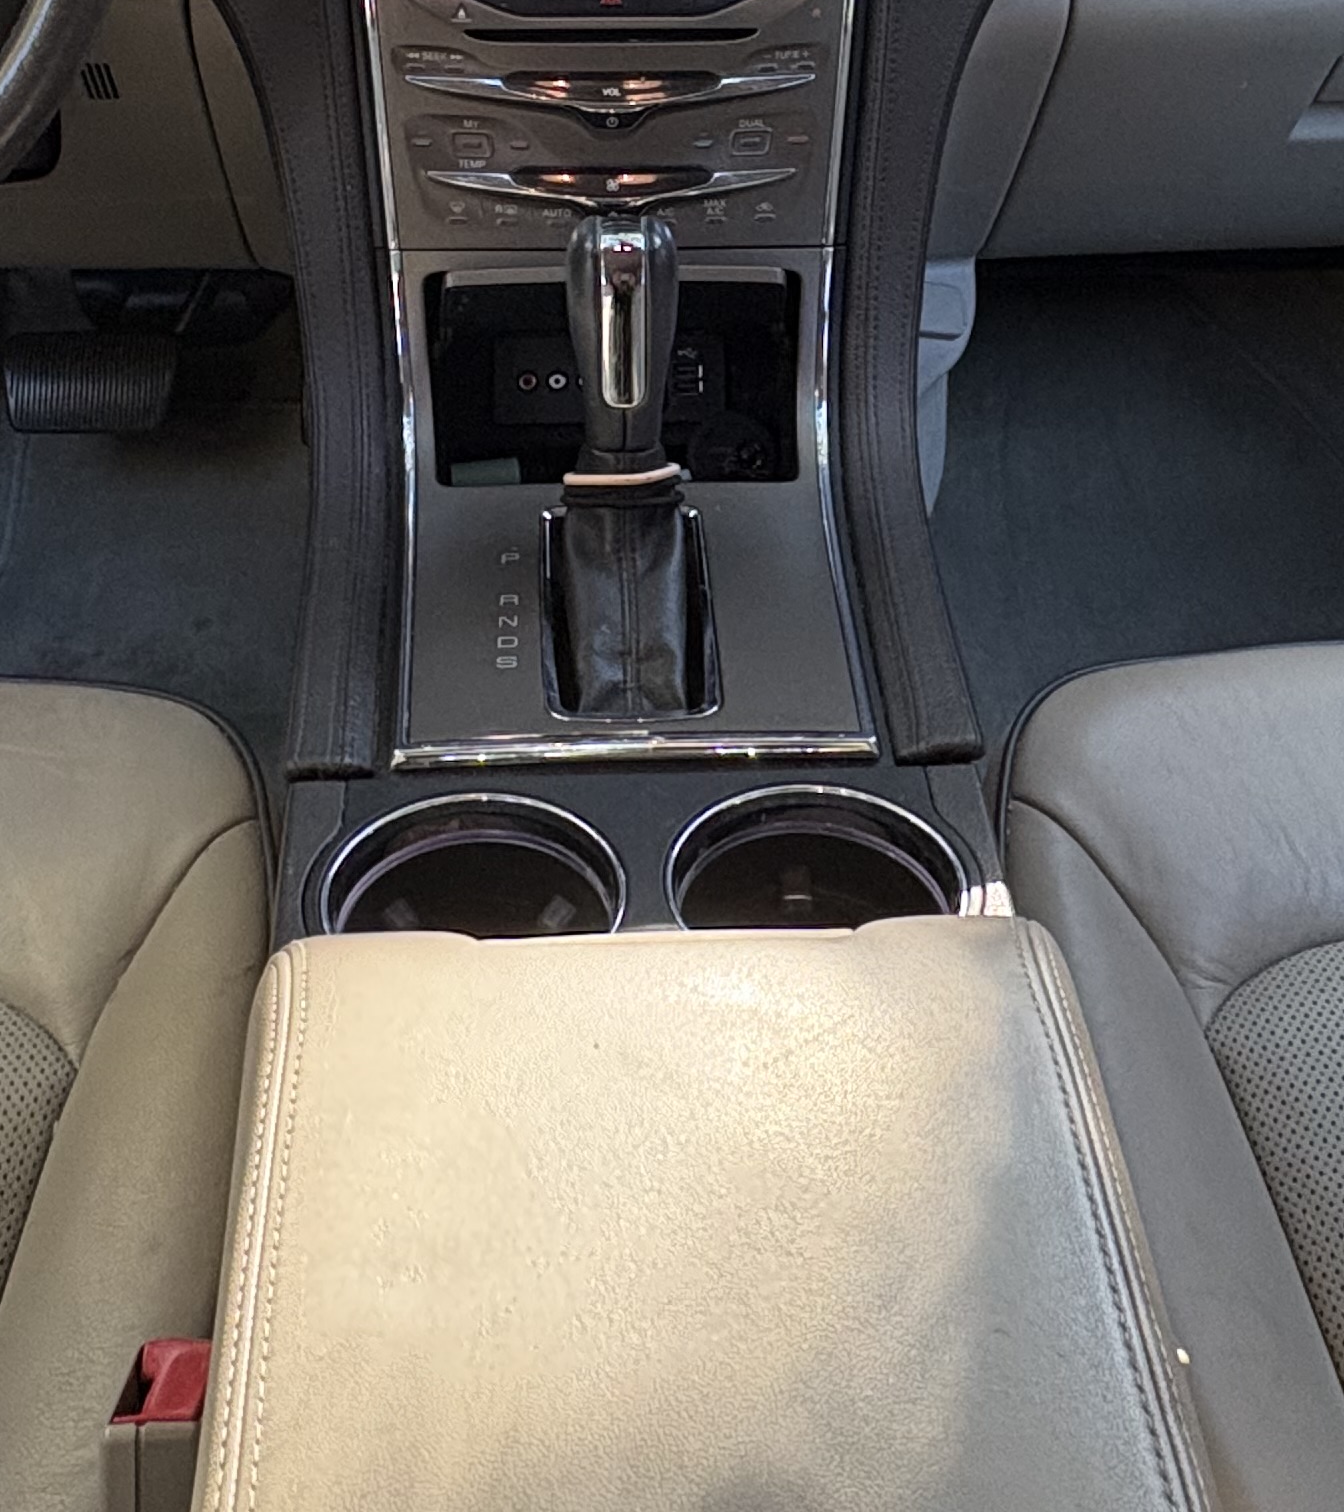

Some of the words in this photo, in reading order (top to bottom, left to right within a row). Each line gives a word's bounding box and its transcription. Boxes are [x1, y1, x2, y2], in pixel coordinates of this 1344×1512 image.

[602, 87, 621, 96] VOL
[739, 119, 765, 128] DUAL
[458, 159, 486, 168] TEMP
[704, 198, 727, 207] MAX
[542, 208, 572, 217] AUTO
[500, 552, 520, 564] P
[498, 615, 518, 627] N
[497, 636, 518, 648] D
[496, 656, 518, 668] S
